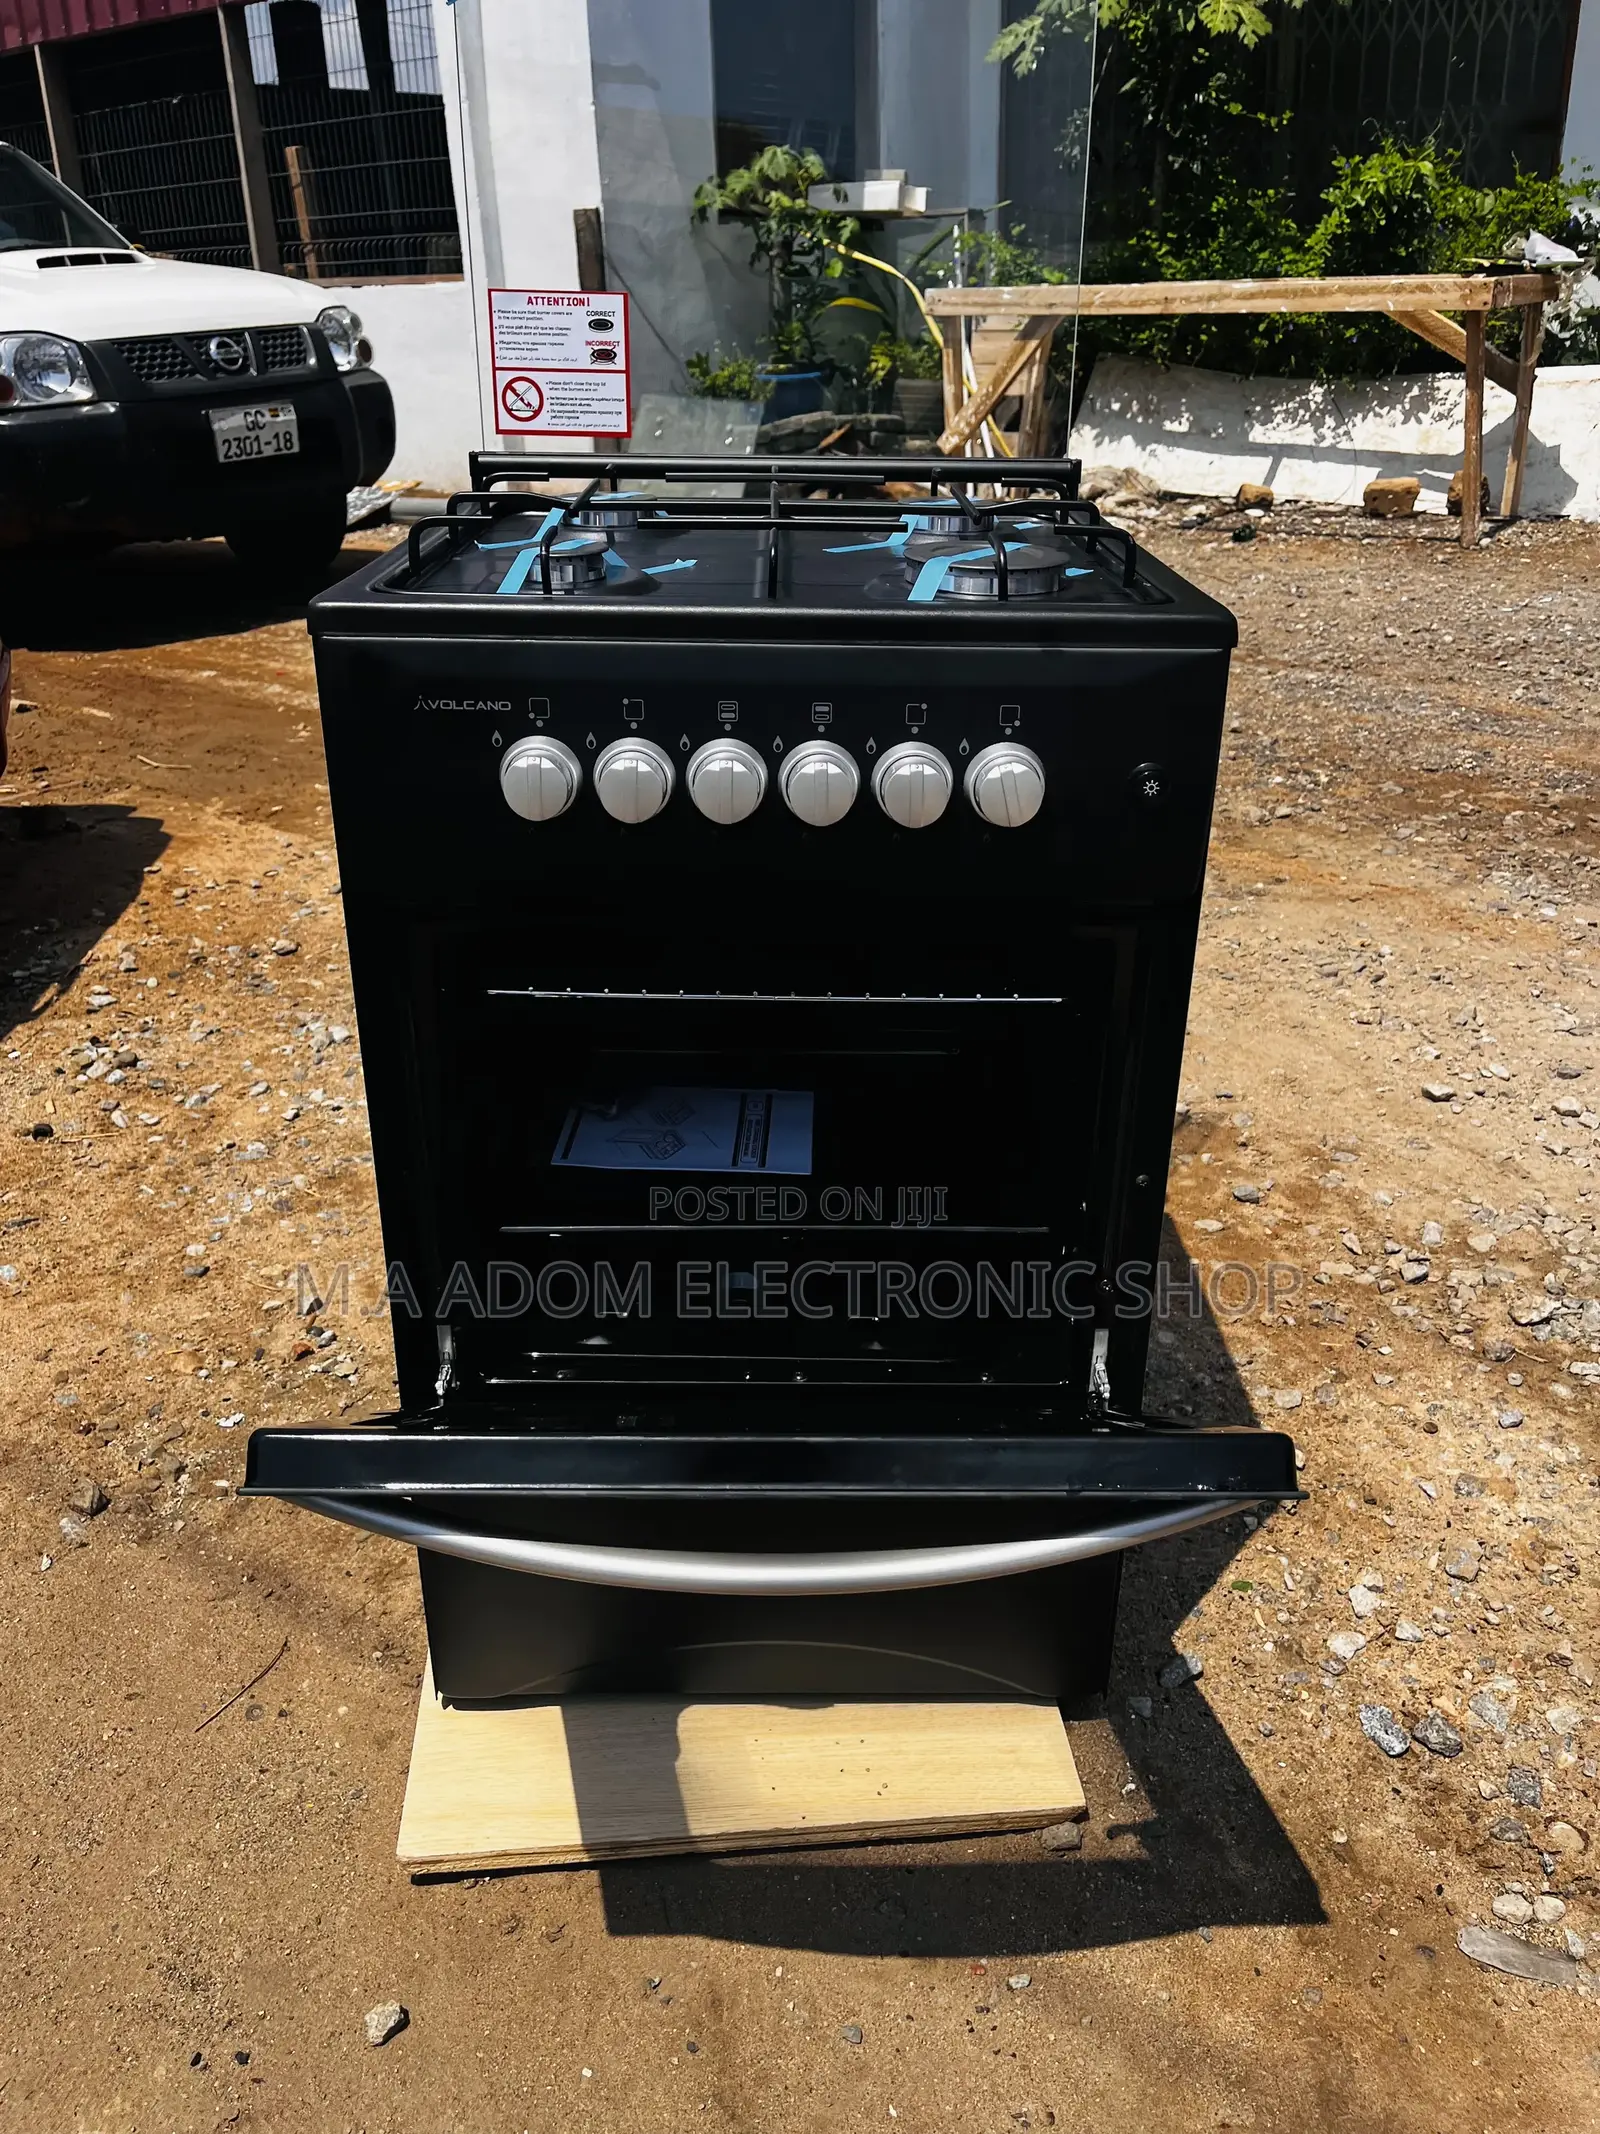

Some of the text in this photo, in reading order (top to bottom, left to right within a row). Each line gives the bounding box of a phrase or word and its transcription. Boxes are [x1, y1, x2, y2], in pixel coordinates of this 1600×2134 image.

[526, 296, 591, 307] ATTENTION!
[243, 409, 267, 432] GC
[222, 430, 294, 460] 2301-18
[428, 699, 511, 711] VOLCANO
